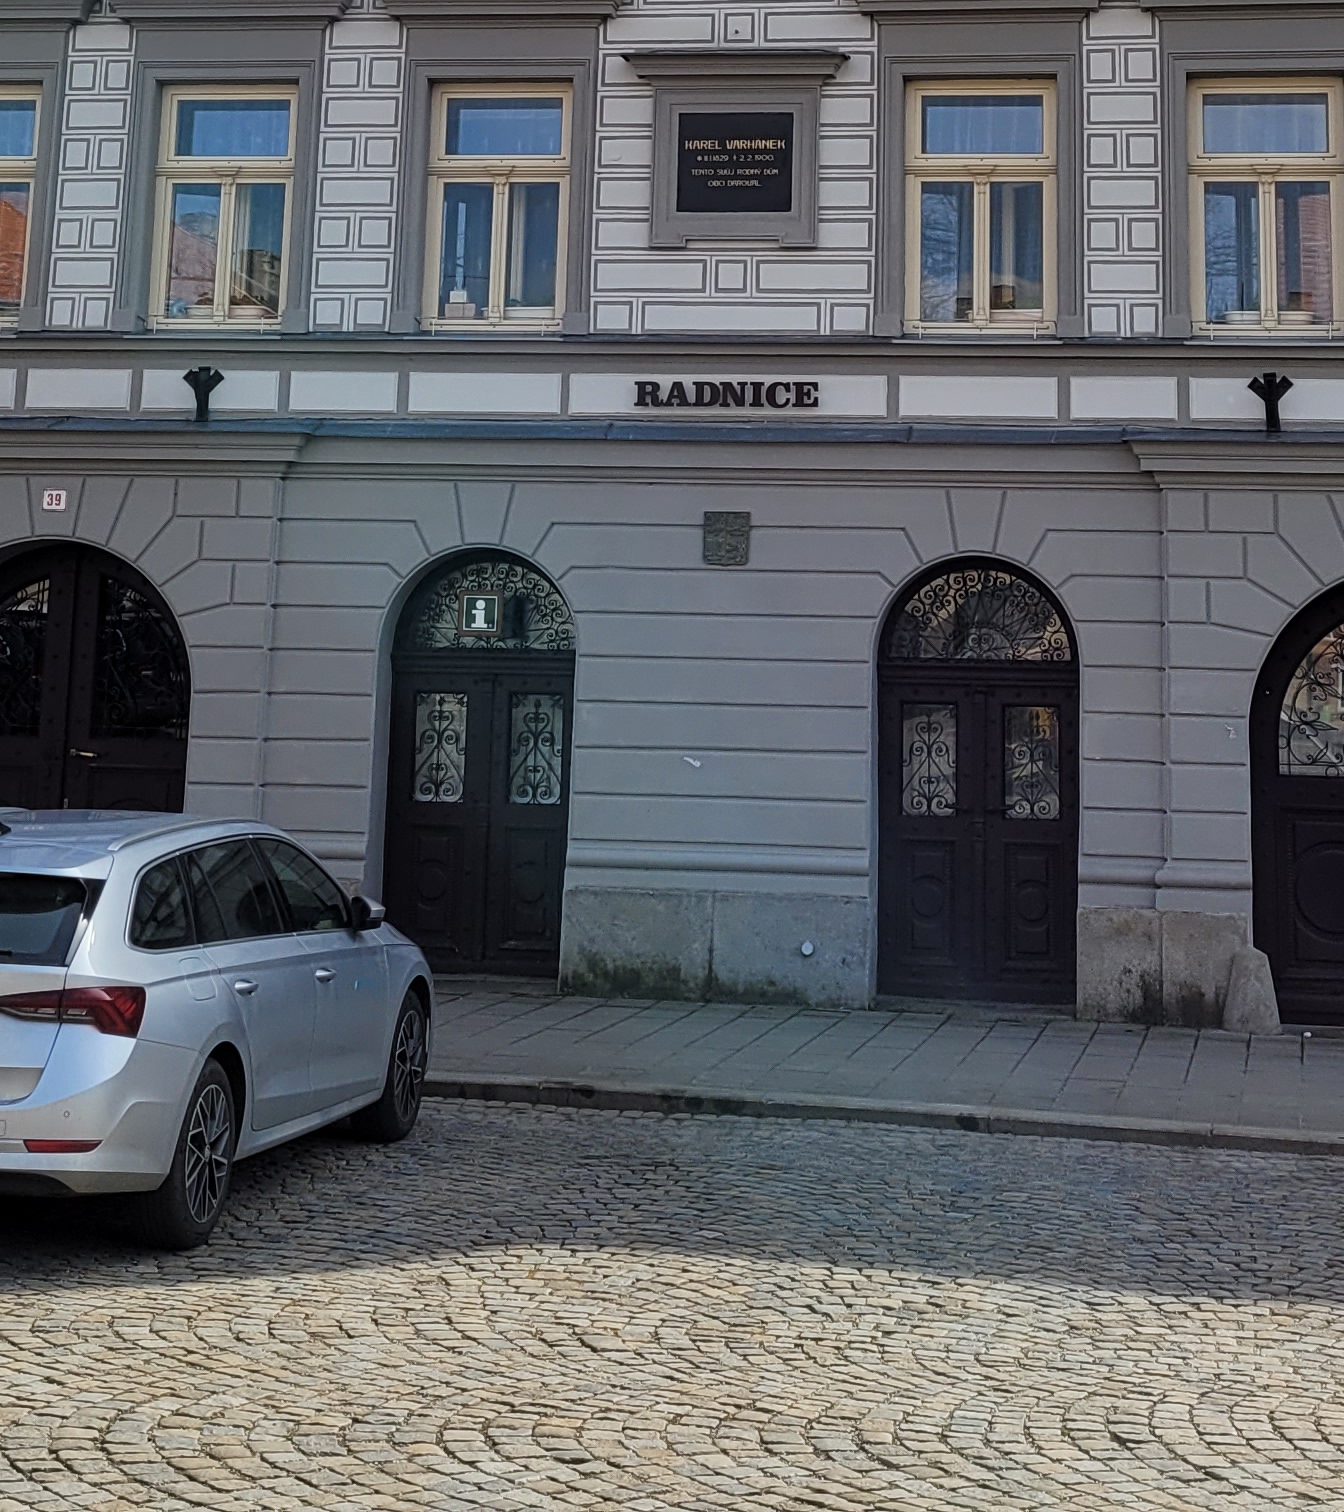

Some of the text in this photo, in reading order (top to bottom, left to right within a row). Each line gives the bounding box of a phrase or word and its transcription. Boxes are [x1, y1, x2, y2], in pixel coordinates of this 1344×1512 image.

[685, 139, 722, 150] KAREL
[633, 381, 820, 409] RADNICE
[47, 493, 62, 507] 39
